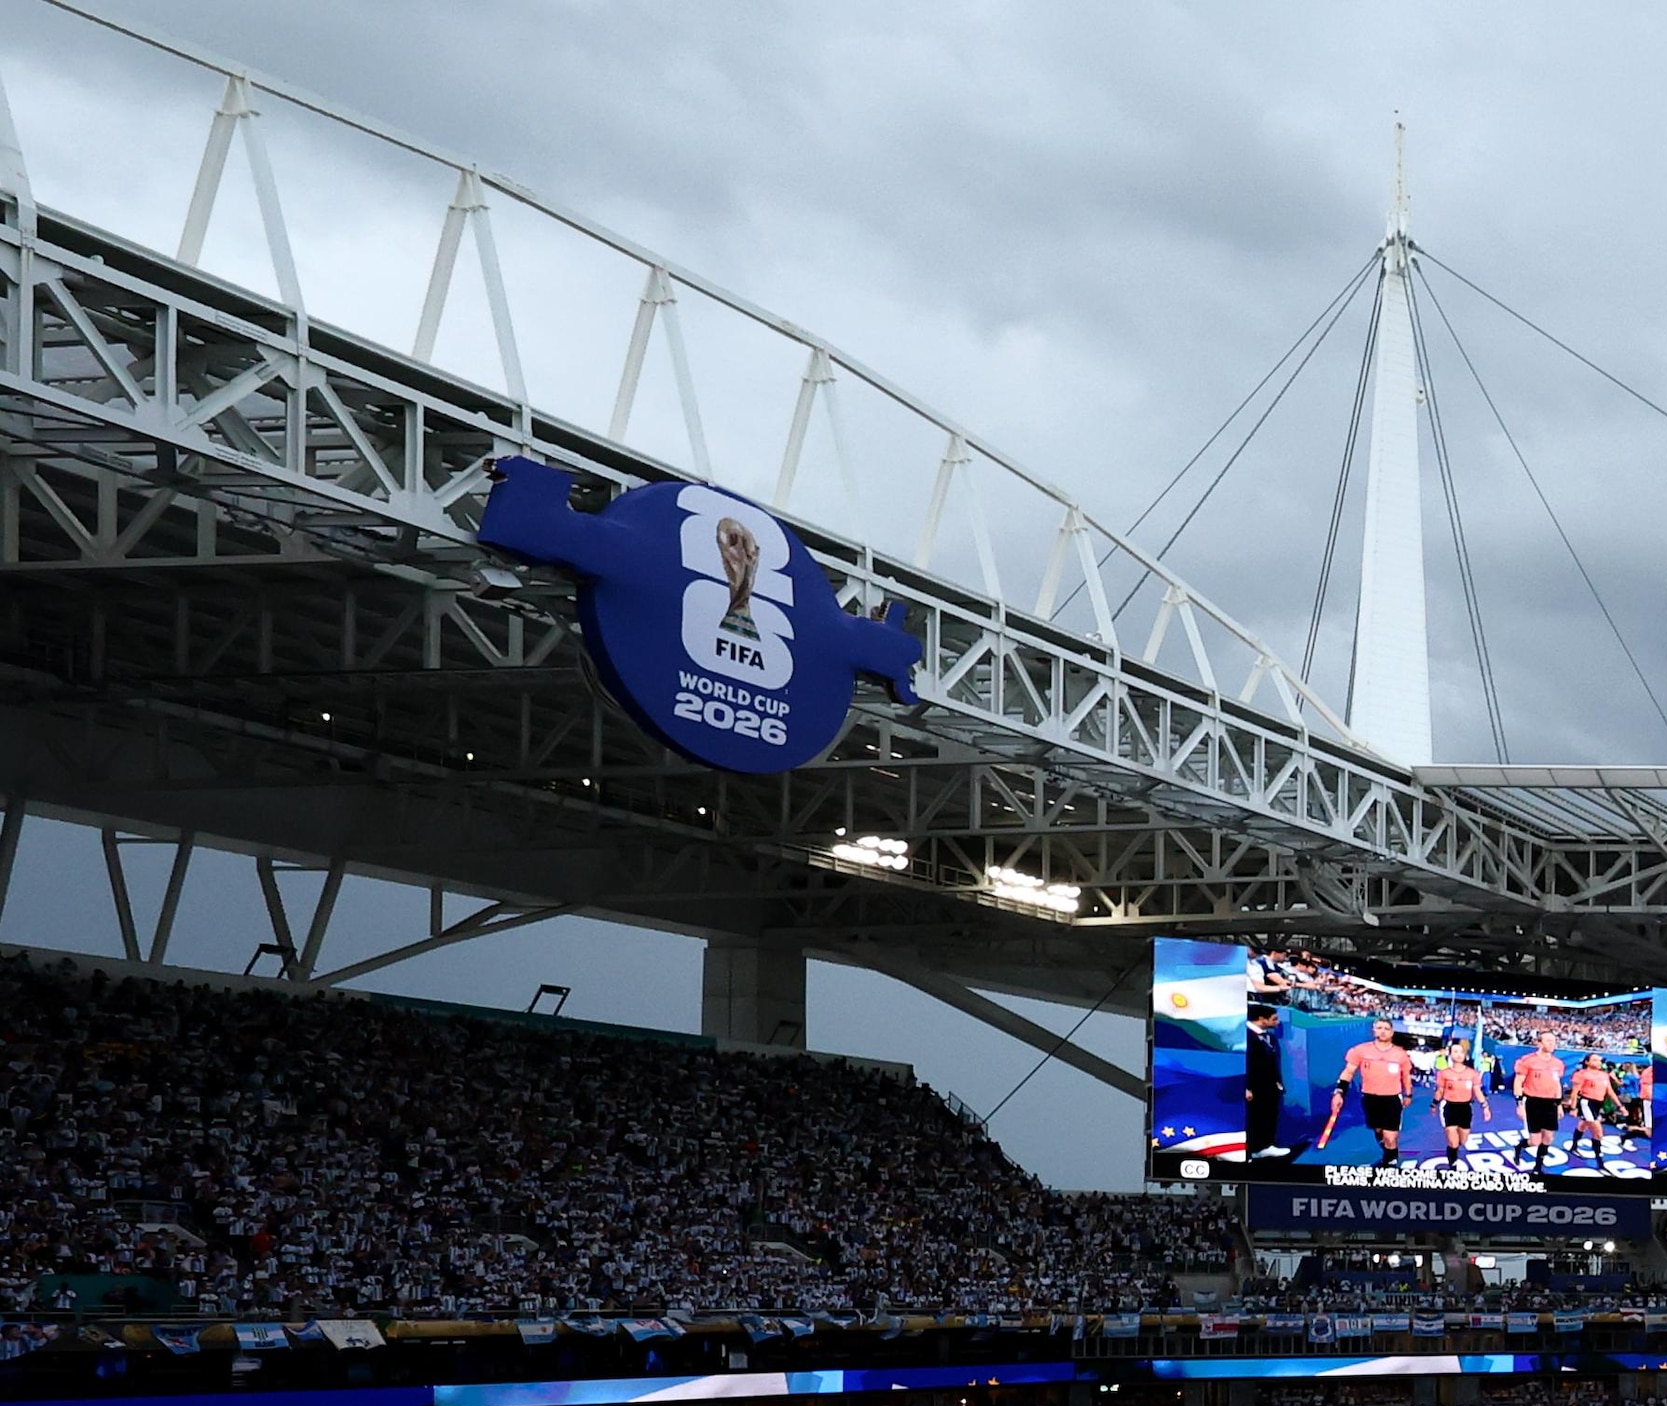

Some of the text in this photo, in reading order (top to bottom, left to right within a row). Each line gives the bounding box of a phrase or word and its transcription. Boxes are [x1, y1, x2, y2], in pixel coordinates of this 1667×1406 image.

[715, 637, 765, 671] FIFA
[678, 670, 791, 721] WORLD CUP
[674, 692, 788, 746] 2026
[1324, 1165, 1373, 1178] PLEASE
[1375, 1167, 1437, 1180] WELCOME
[1503, 1172, 1530, 1183] TWO
[1373, 1176, 1443, 1190] ARGENTINA
[1443, 1179, 1469, 1190] AND
[1470, 1180, 1504, 1192] CABO
[1292, 1198, 1617, 1226] FIFA WORLD CUP 2026
